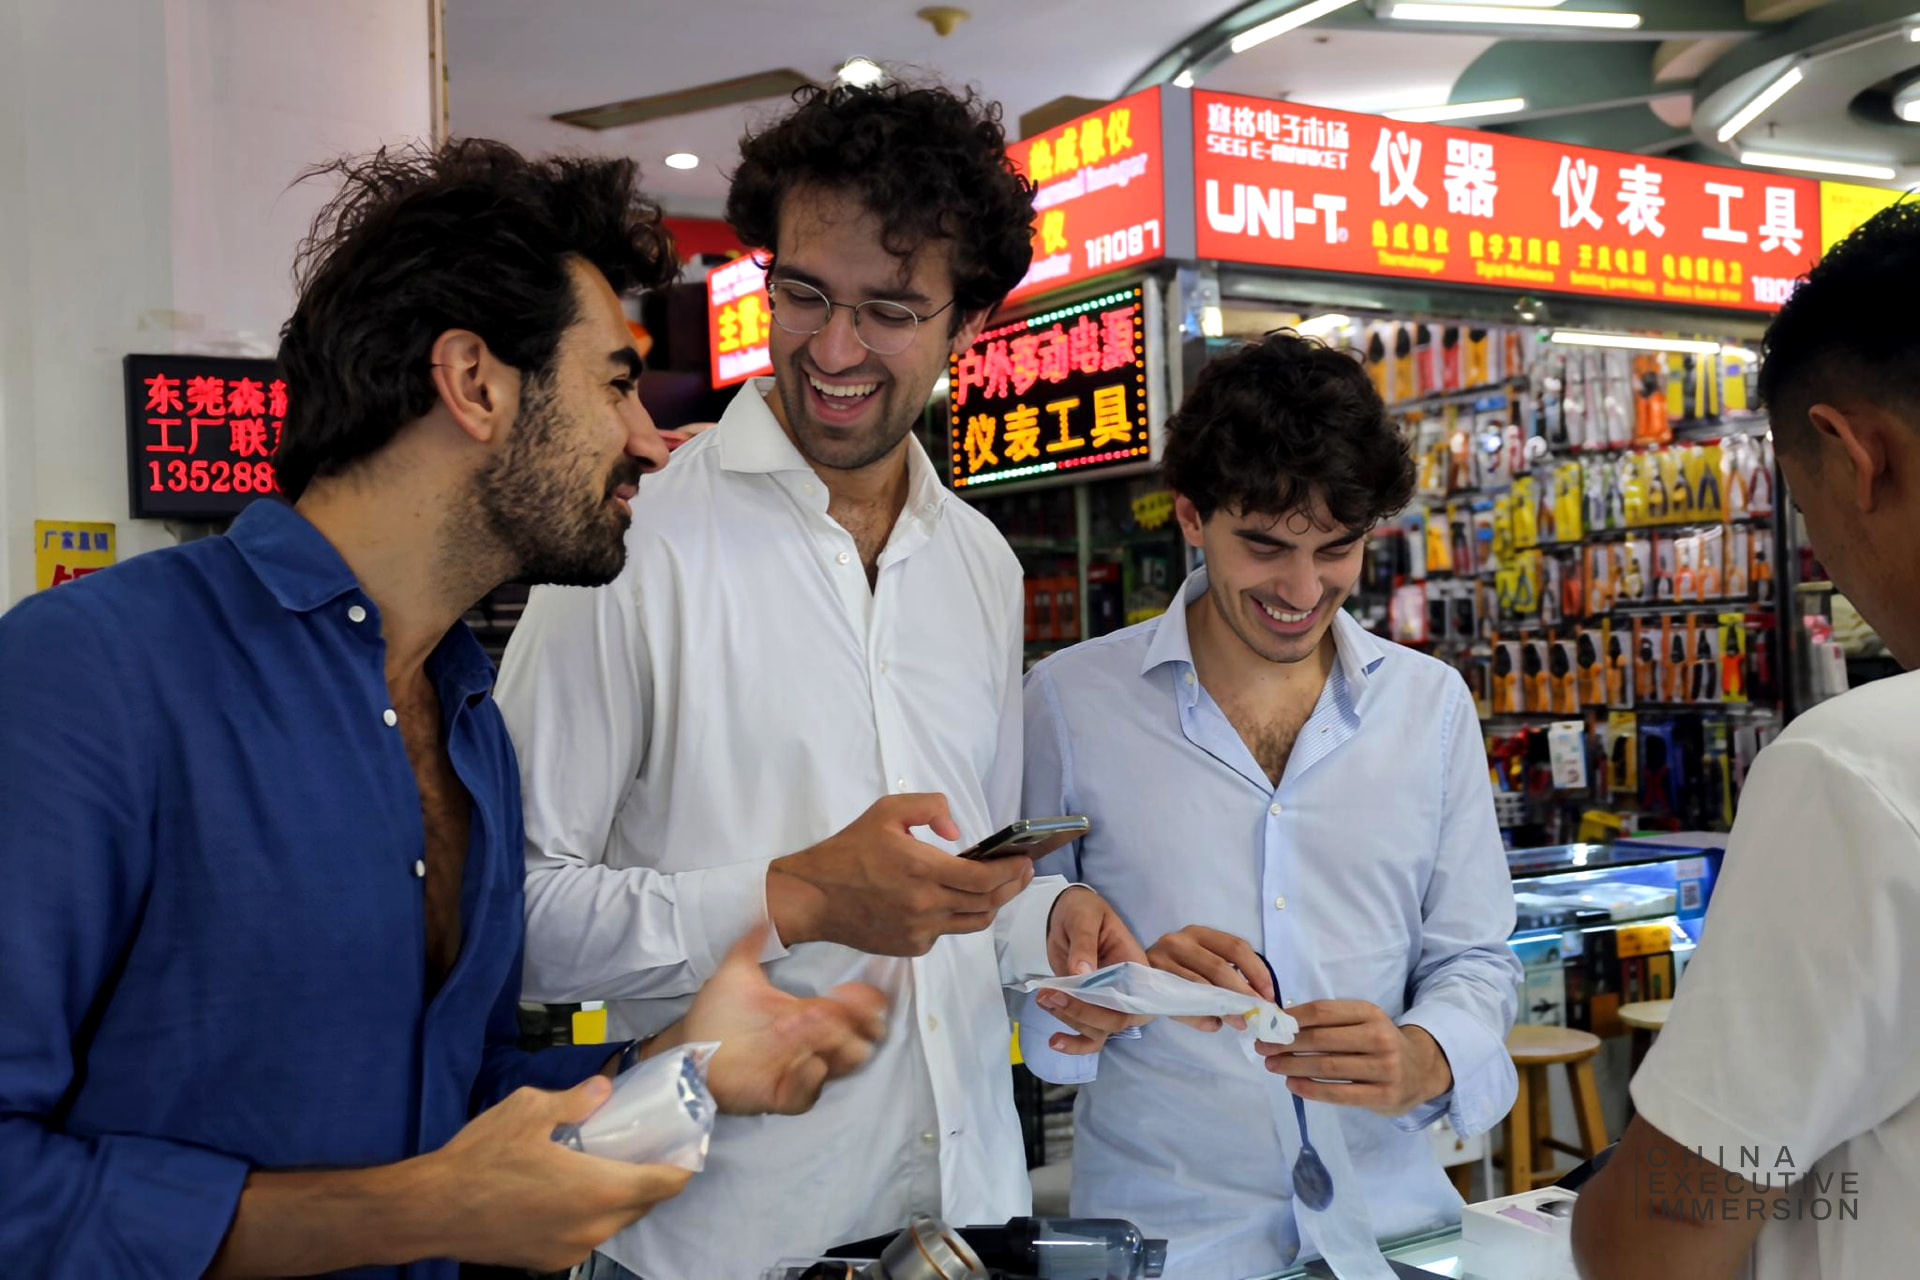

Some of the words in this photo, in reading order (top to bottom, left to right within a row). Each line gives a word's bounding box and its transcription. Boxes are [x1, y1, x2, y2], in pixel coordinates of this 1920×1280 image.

[1206, 134, 1248, 157] SEG
[1370, 127, 1498, 218] 仪器
[1552, 155, 1665, 238] 仪表
[1702, 182, 1803, 256] 工具
[957, 306, 1136, 406] 户外移动电源
[963, 384, 1133, 473] 仪表工具
[149, 459, 282, 493] 135288
